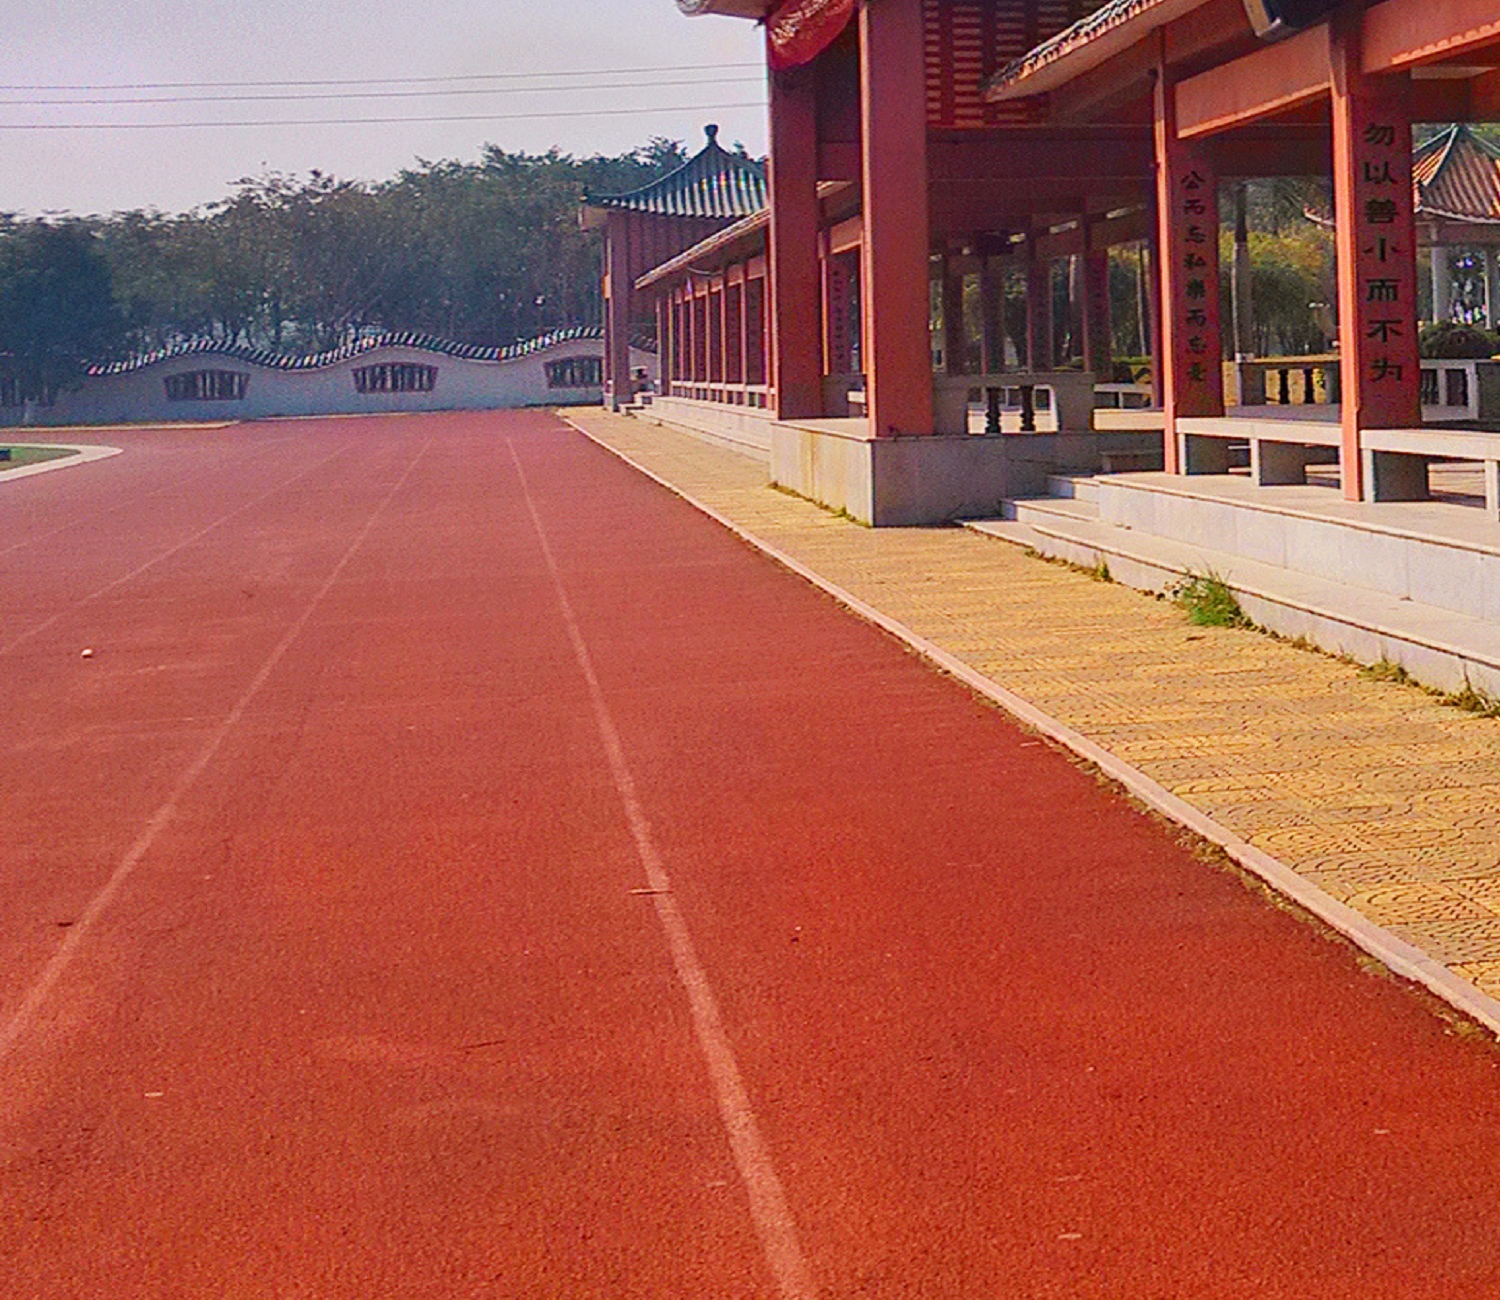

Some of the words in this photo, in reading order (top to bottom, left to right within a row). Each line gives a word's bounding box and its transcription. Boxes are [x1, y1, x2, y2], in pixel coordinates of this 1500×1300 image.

[1362, 121, 1404, 383] 勿以善小而不为
